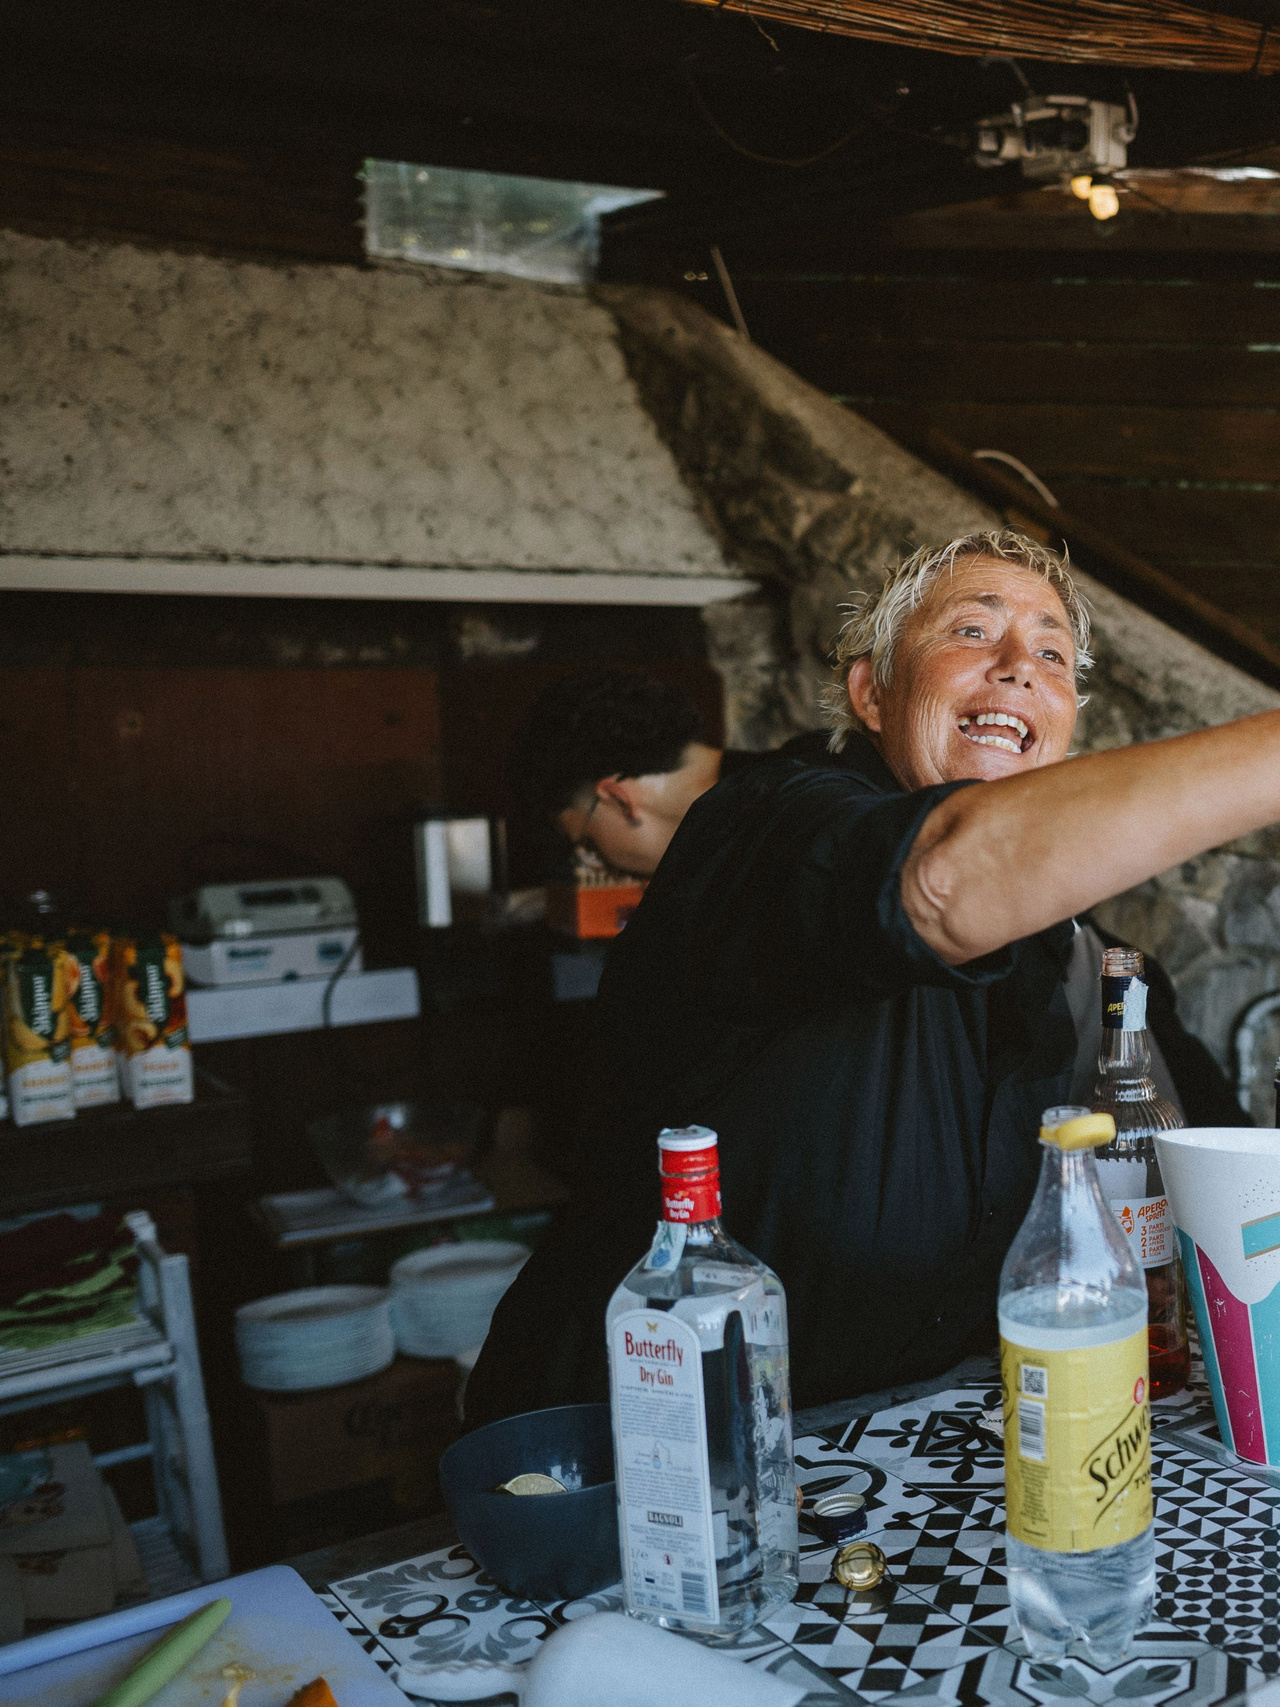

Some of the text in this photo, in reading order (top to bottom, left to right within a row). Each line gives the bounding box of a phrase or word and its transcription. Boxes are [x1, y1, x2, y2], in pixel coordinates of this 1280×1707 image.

[1141, 1225, 1148, 1236] 3
[1141, 1237, 1147, 1247] 2
[1142, 1249, 1147, 1258] 1
[625, 1331, 683, 1367] Butterfly
[640, 1366, 674, 1386] Dry Gin
